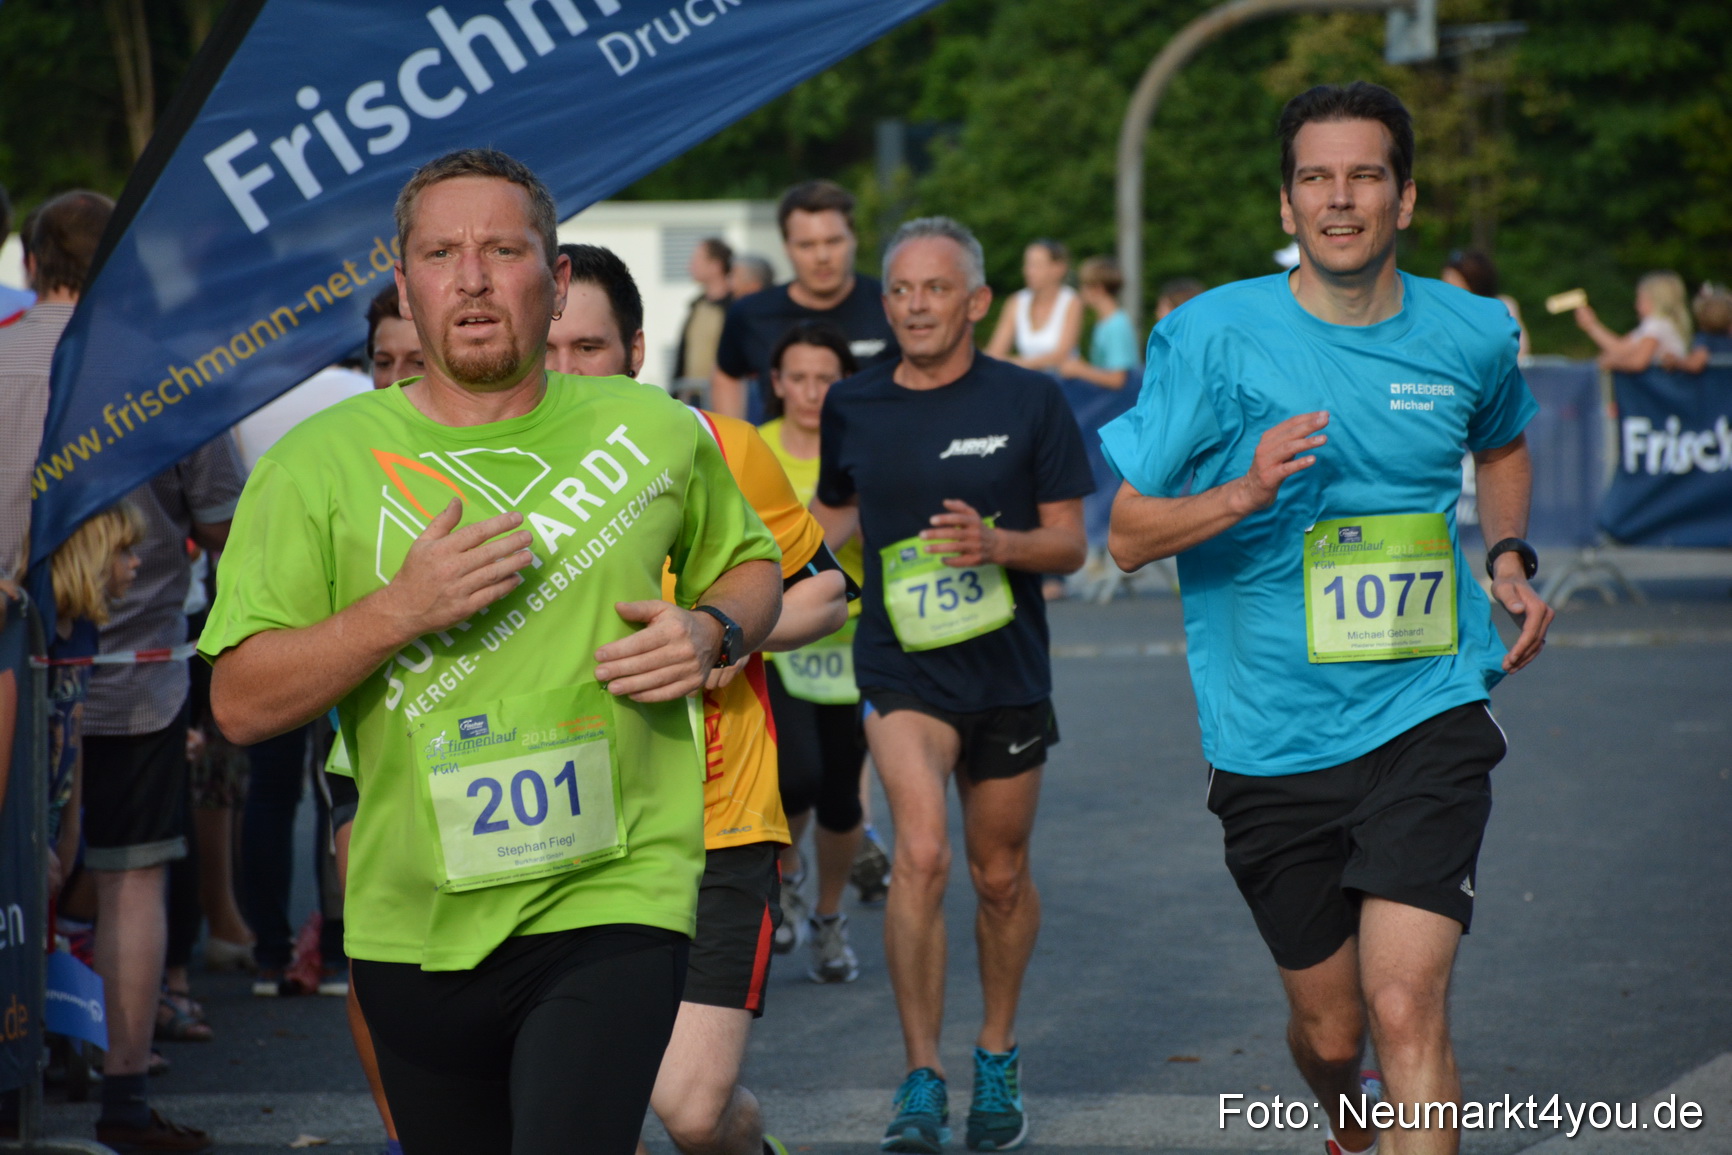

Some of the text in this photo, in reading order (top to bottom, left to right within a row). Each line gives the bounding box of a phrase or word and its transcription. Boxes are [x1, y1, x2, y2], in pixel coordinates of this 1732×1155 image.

[1401, 383, 1455, 396] PFLEIDERER
[1390, 399, 1434, 411] Michael
[1328, 540, 1384, 553] firmenlauf
[480, 608, 527, 653] UND
[525, 468, 675, 613] GEBÄUDETECHNIK
[908, 569, 983, 619] 753
[1323, 570, 1444, 621] 1077
[1347, 627, 1424, 640] Michael Gebhardt
[447, 728, 518, 753] firmenlauf
[521, 728, 558, 747] 2016
[466, 759, 582, 837] 201
[497, 833, 576, 858] Stephan Fiegl
